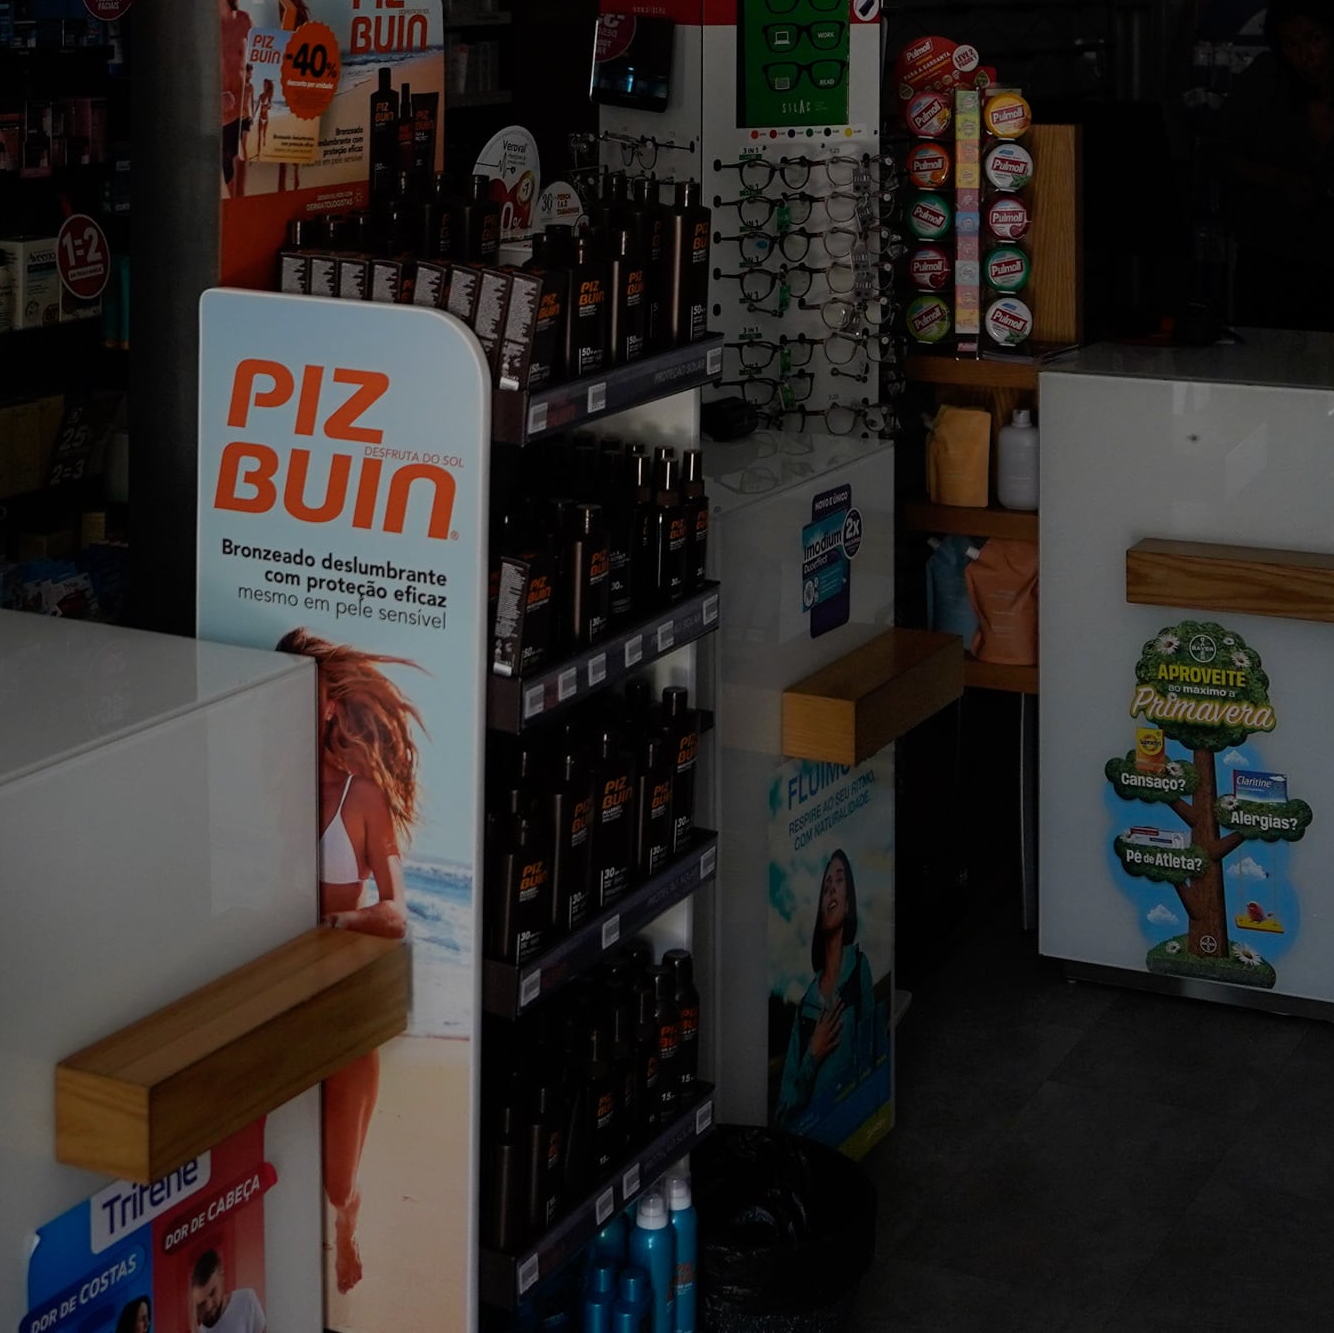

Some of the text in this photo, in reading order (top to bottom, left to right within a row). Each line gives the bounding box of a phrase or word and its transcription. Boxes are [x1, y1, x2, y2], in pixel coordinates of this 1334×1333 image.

[253, 34, 274, 49] PIZ
[350, 14, 429, 54] BUIN
[286, 42, 338, 79] -40%
[915, 99, 942, 129] Pulmoll
[992, 106, 1025, 124] Pulmoll
[227, 358, 390, 444] PIZ
[364, 445, 465, 467] DESFRUTA DO SOL
[214, 441, 457, 540] BUIN
[804, 528, 842, 561] Imodium
[222, 538, 447, 587] Bronzeado deslumbrante
[265, 569, 447, 608] com proteção eficaz
[238, 585, 447, 630] mesmo em pele sensível
[1156, 663, 1247, 688] APROVEITE
[1168, 684, 1236, 698] ao máximo a
[1132, 685, 1275, 730] Primavera
[1120, 772, 1186, 792] Cansaço?
[1236, 774, 1272, 788] Claritine
[789, 803, 822, 837] RESPIRE
[822, 795, 835, 812] AO
[835, 785, 851, 806] SEU
[1230, 810, 1299, 831] Alergias?
[1126, 848, 1203, 872] Pé de Atleta?
[164, 1173, 261, 1252] DOR DE CABEÇA
[31, 1251, 138, 1333] DOR DE COSTAS
